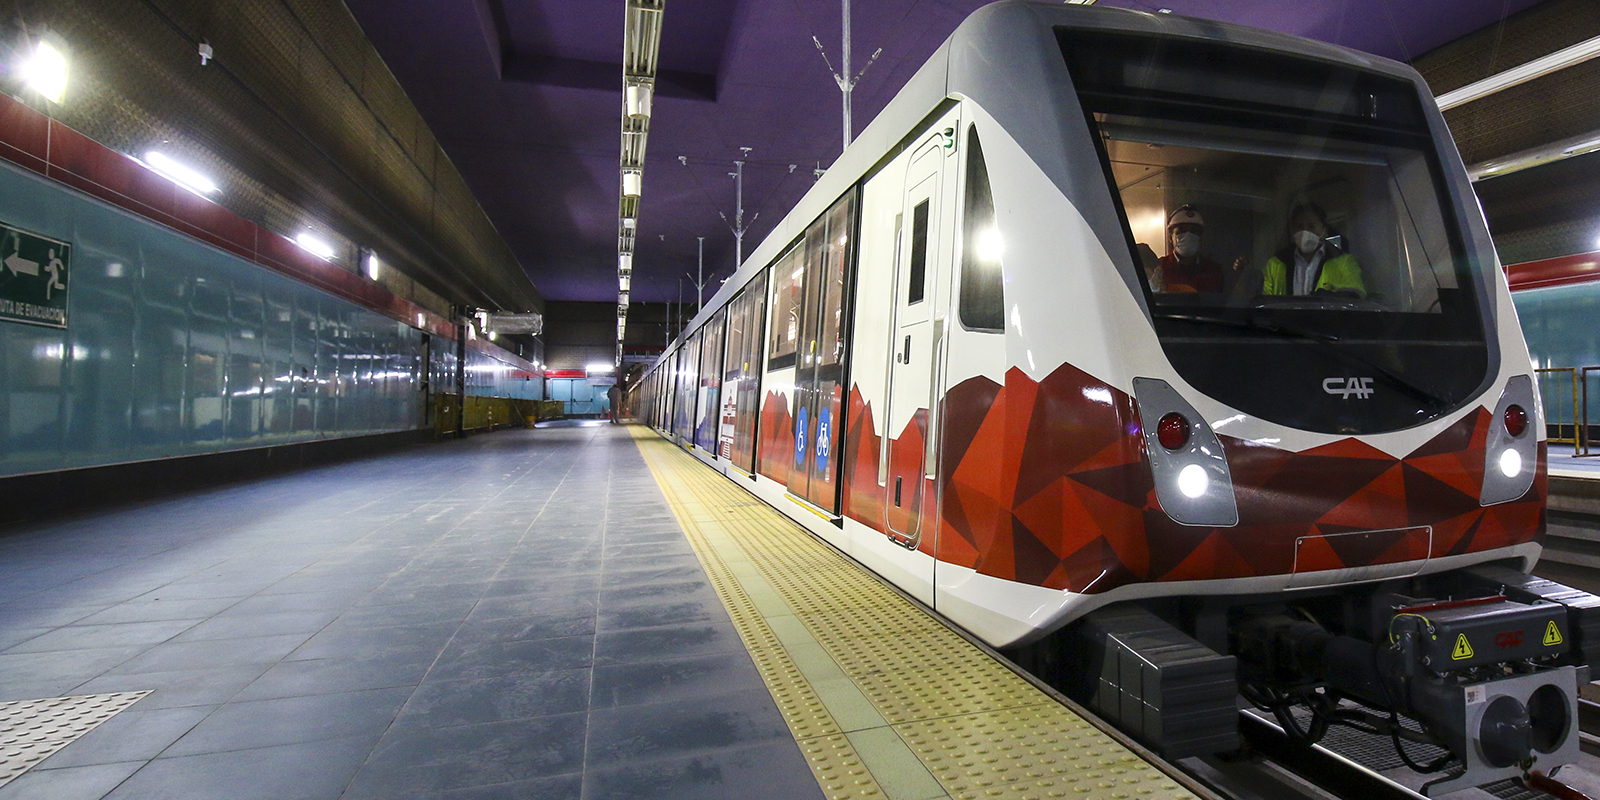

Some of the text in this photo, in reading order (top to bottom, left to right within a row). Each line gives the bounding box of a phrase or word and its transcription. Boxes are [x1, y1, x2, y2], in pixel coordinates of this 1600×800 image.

[15, 301, 25, 316] DE
[1322, 377, 1375, 400] CAF
[1495, 630, 1524, 649] CAF
